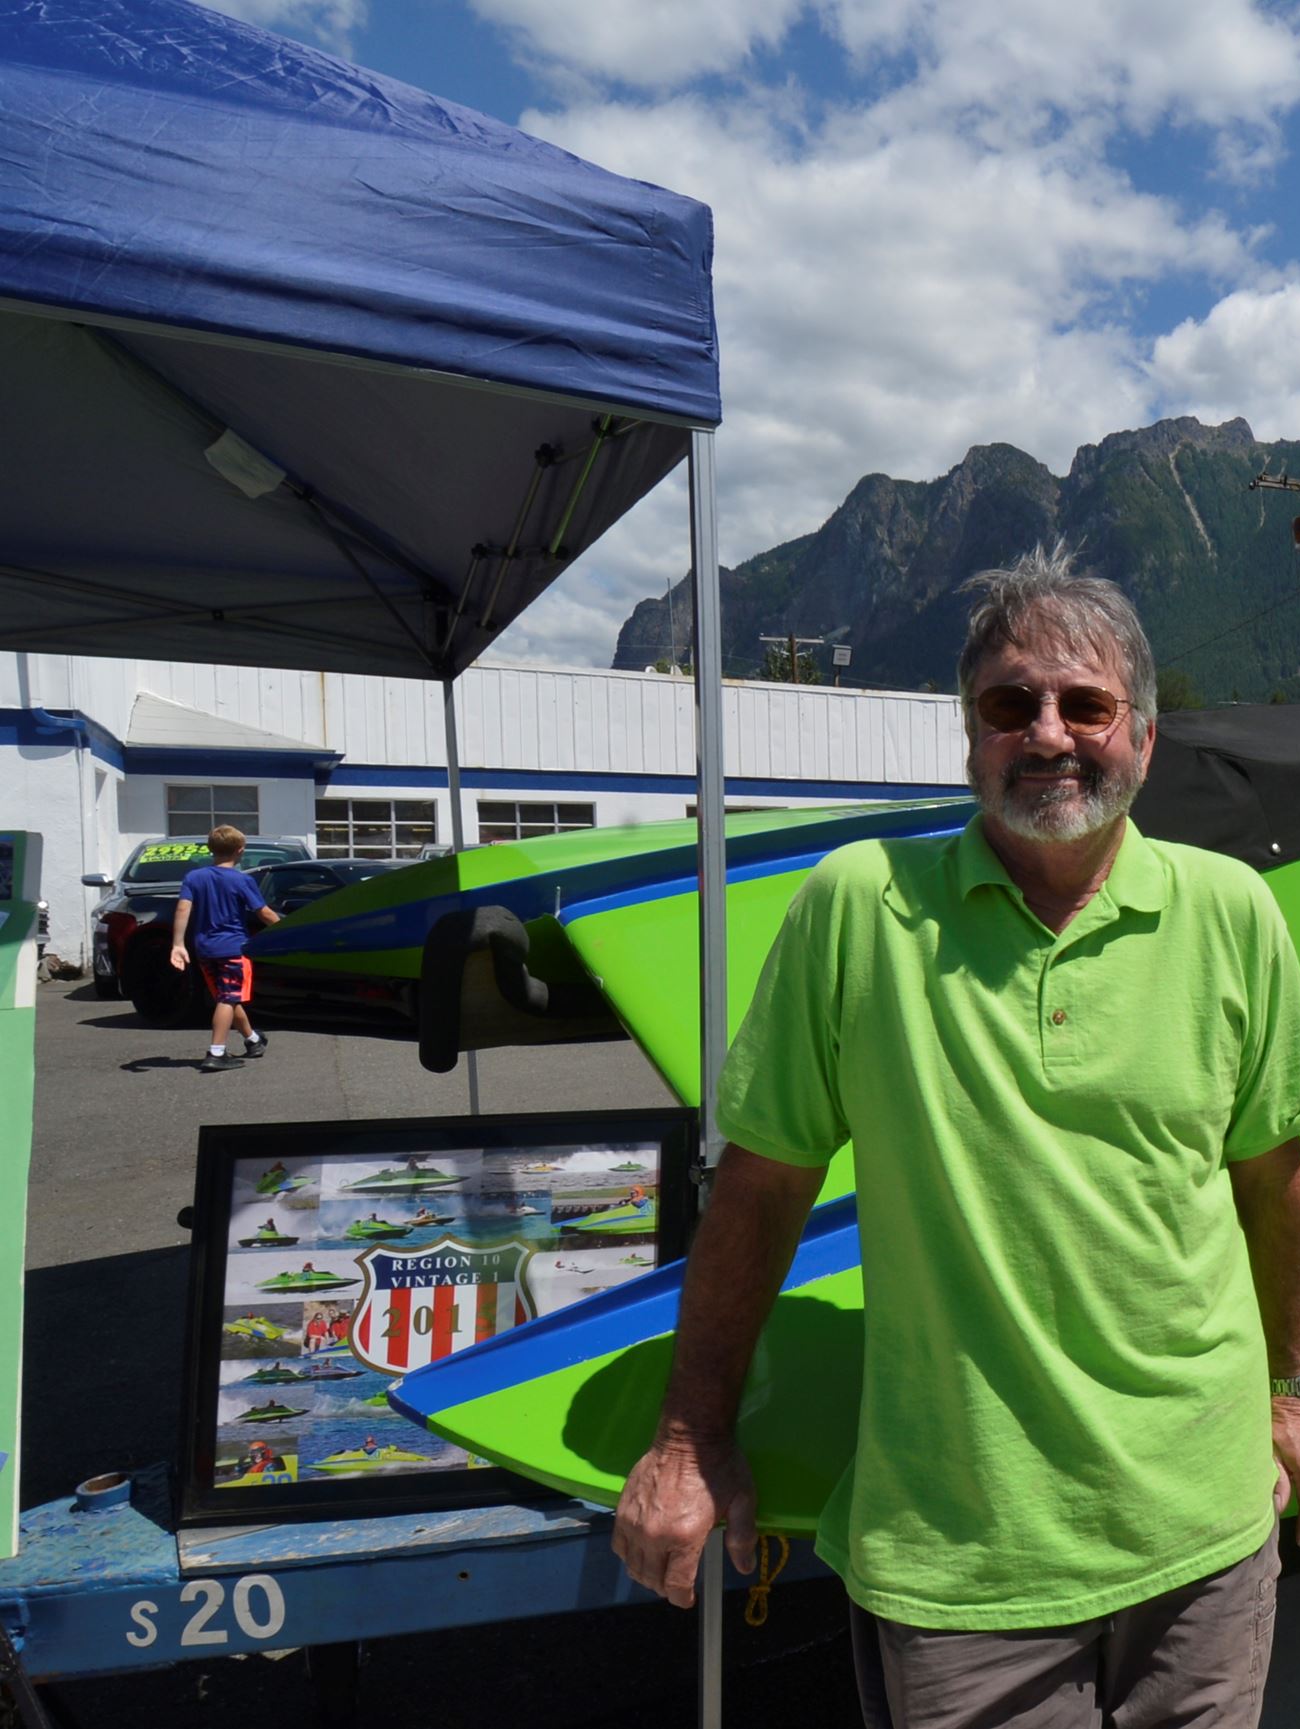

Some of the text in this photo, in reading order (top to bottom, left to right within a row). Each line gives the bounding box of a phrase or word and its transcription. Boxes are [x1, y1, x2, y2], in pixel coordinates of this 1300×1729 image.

[391, 1255, 472, 1272] REGION
[391, 1271, 482, 1289] VINTAGE
[180, 1573, 286, 1647] 20
